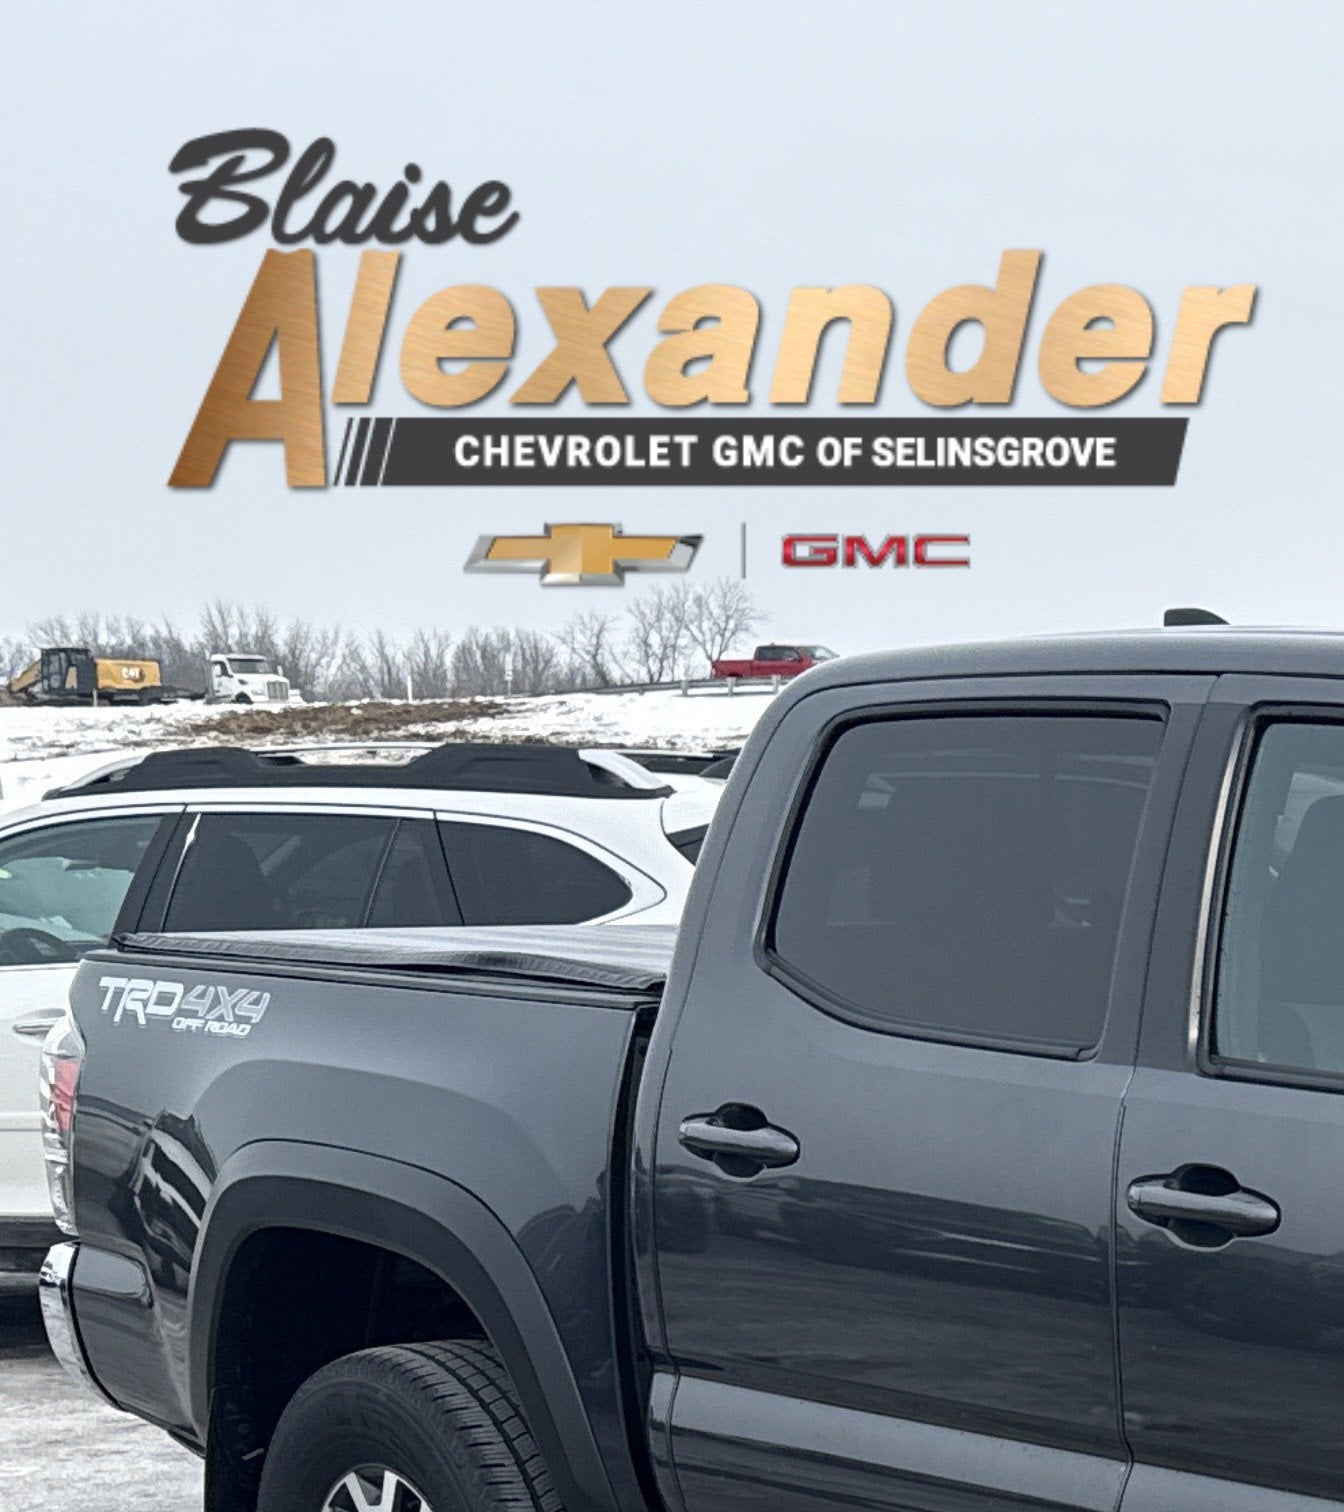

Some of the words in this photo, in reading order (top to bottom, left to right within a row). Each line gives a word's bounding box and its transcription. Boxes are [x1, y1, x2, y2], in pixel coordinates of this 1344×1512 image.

[99, 976, 184, 1026] TRD
[172, 1017, 205, 1033] OFF
[205, 1020, 252, 1037] ROAD
